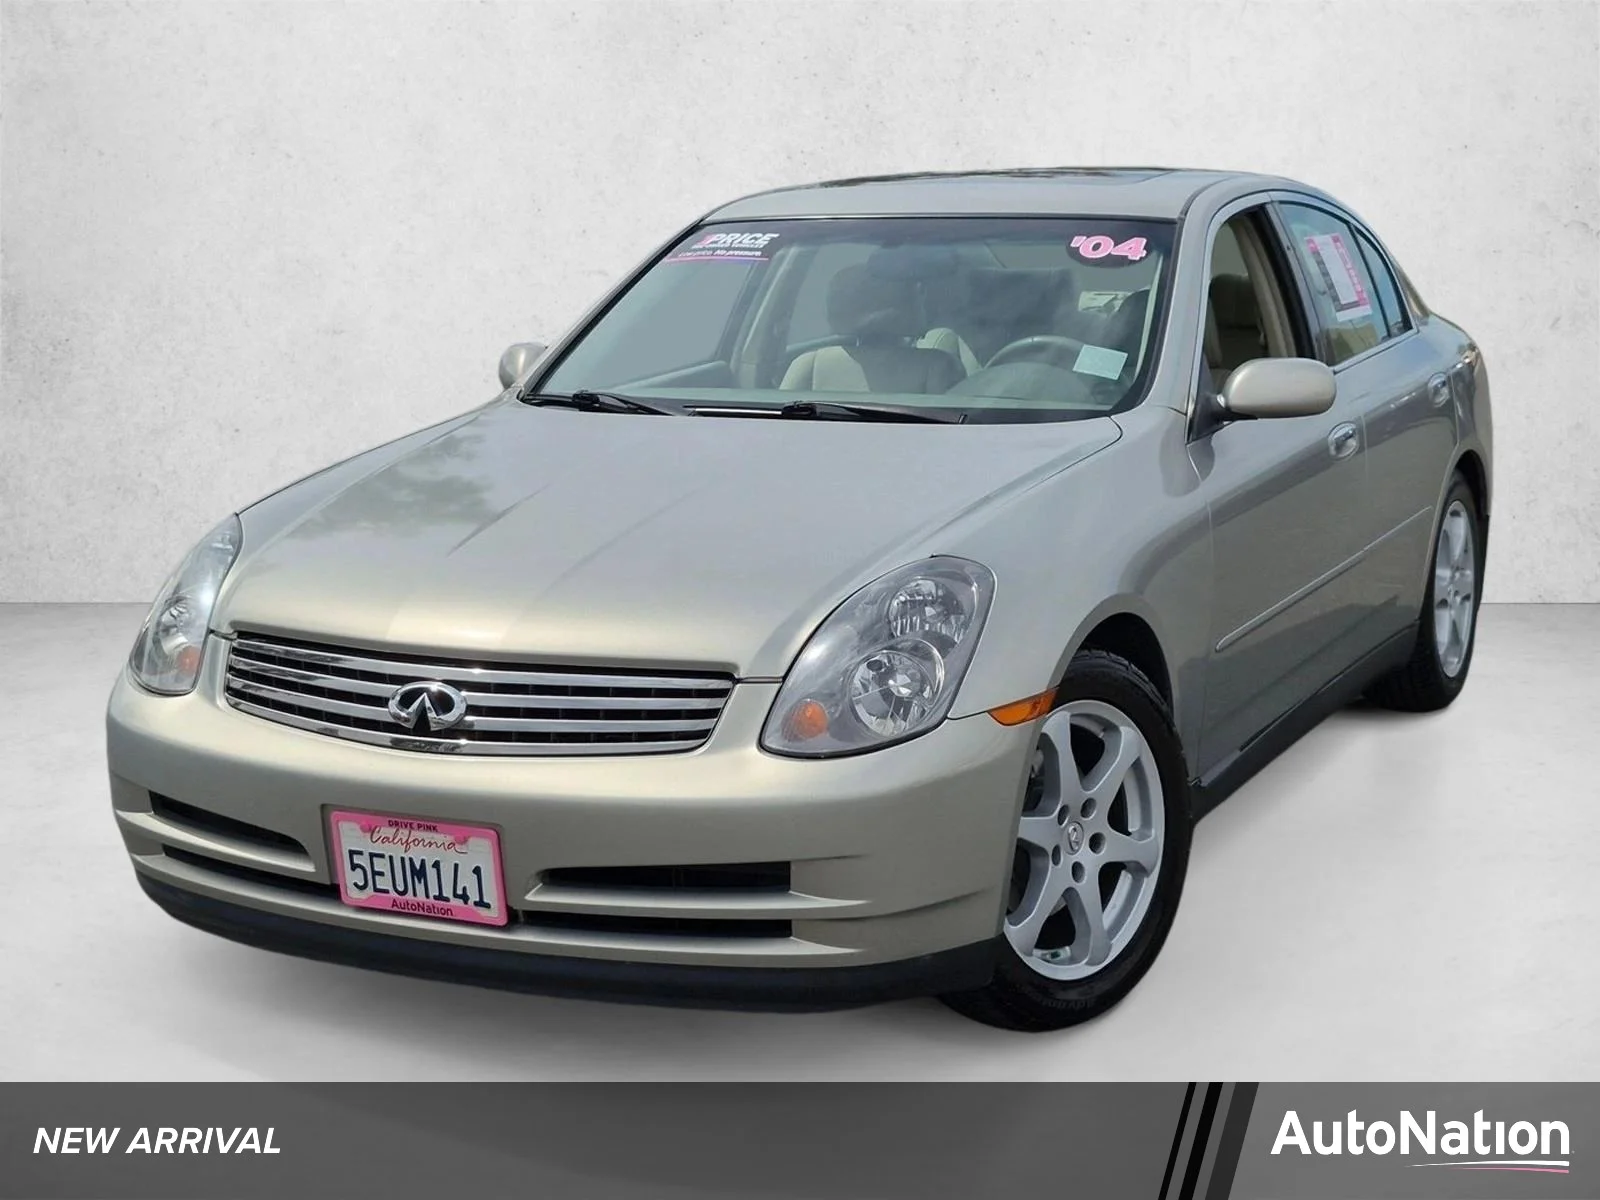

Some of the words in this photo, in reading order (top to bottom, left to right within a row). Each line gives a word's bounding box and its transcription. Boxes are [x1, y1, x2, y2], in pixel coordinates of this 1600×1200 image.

[1070, 235, 1147, 260] '04
[388, 819, 415, 831] DRIVE
[417, 822, 438, 833] PINK
[369, 826, 468, 854] California
[348, 849, 491, 909] 5EUM141
[391, 899, 453, 917] AutoNation
